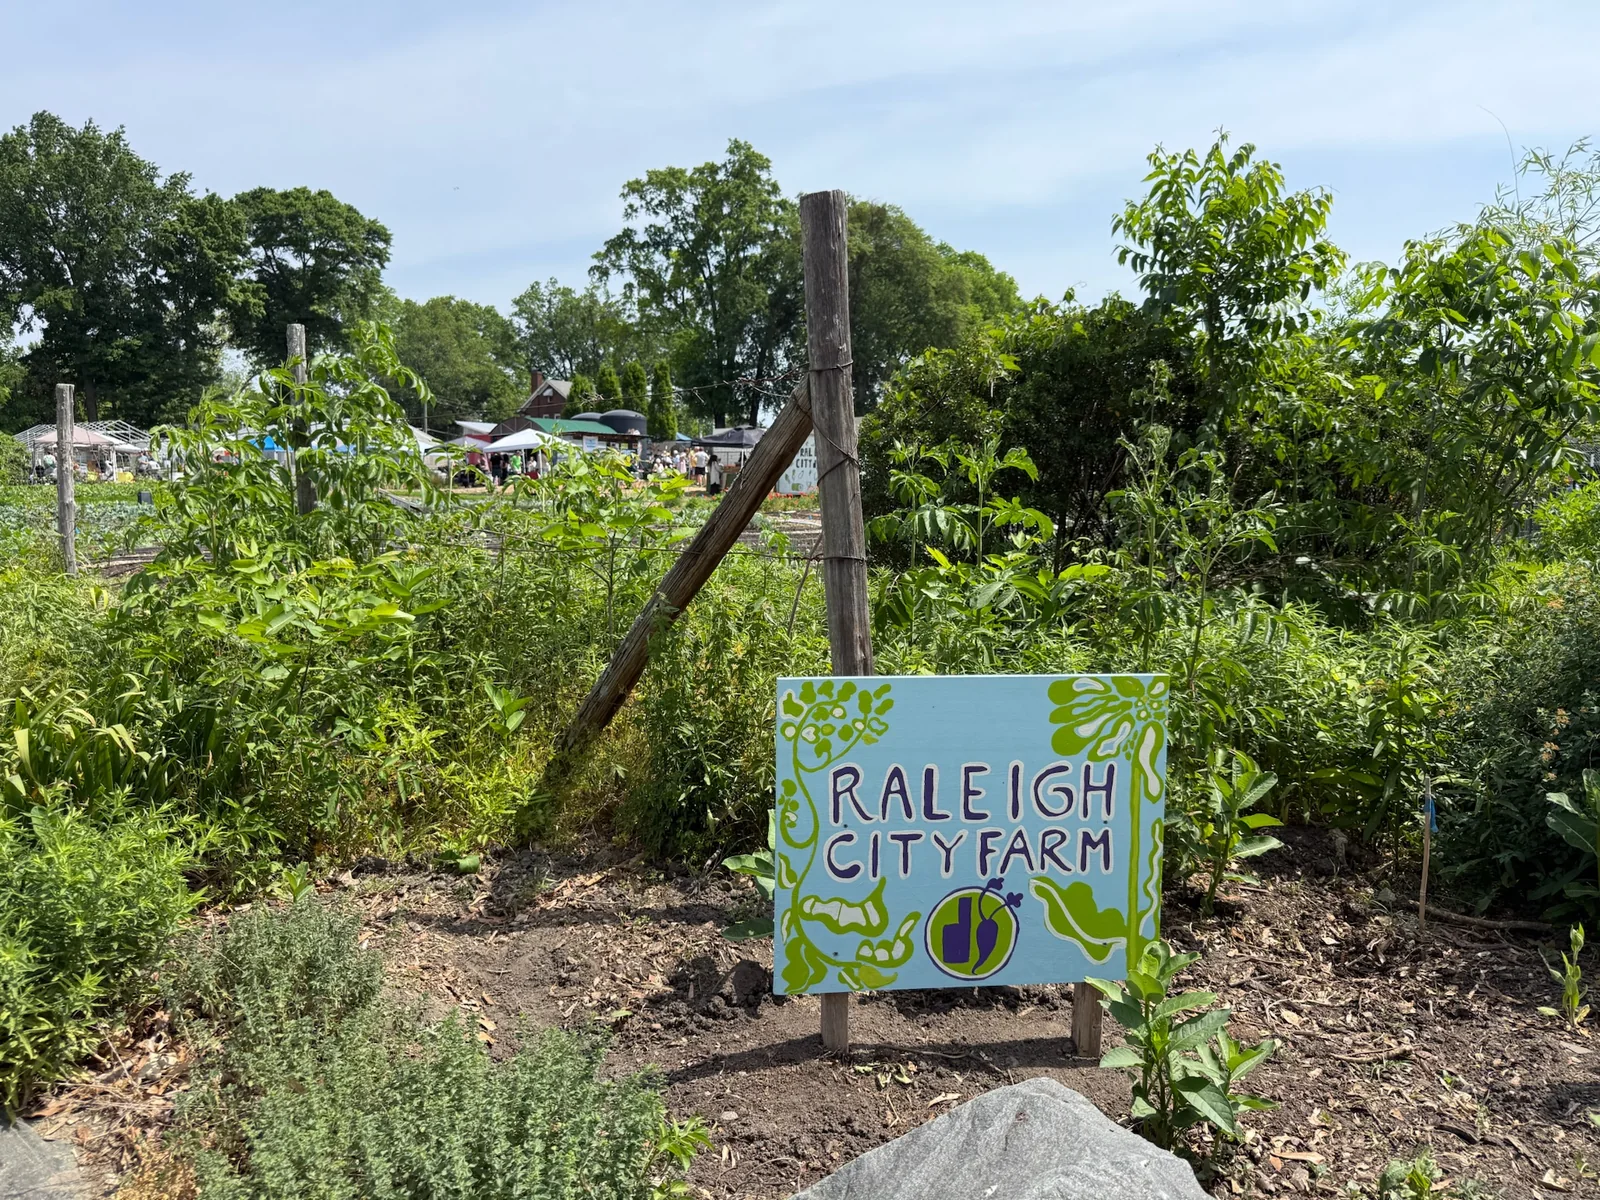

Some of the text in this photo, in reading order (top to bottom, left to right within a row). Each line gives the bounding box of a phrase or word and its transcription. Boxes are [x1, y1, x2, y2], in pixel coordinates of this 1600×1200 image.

[800, 447, 816, 457] RAL
[830, 762, 1116, 825] RALEIGH
[825, 827, 1112, 880] CITY FARM
